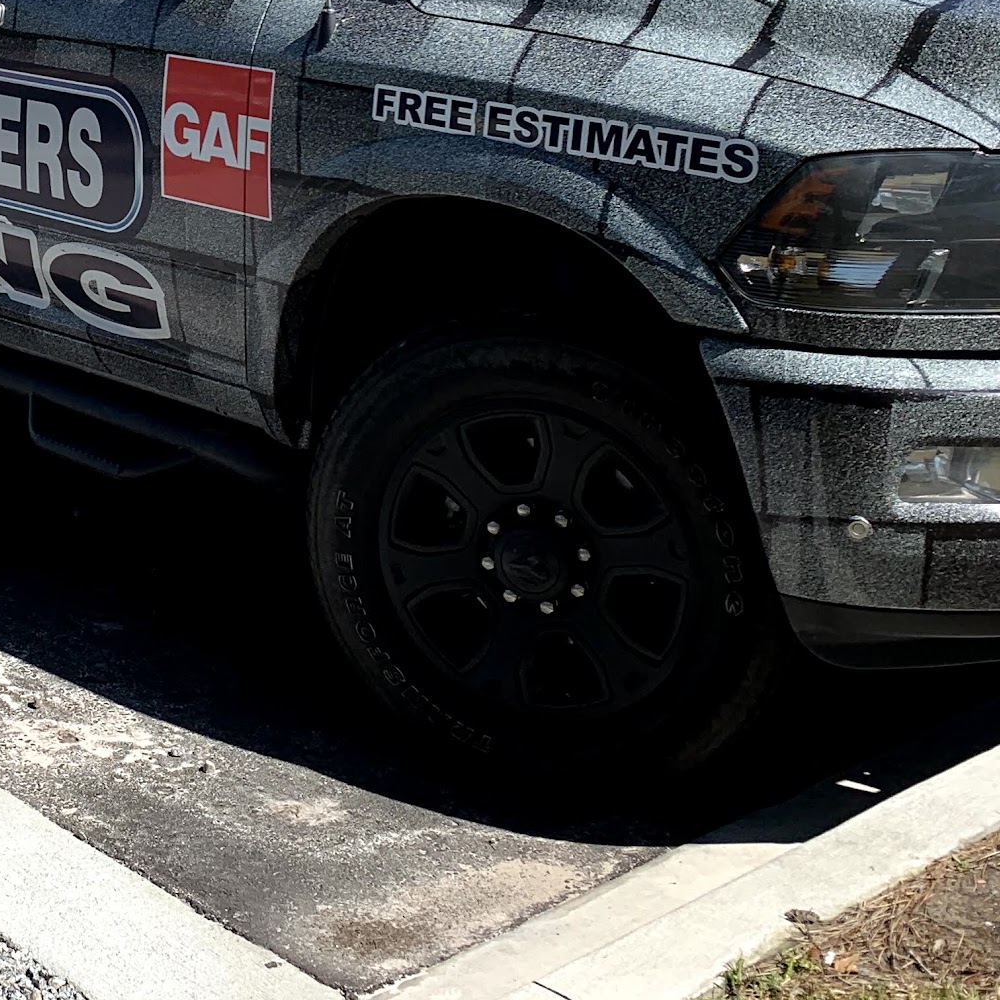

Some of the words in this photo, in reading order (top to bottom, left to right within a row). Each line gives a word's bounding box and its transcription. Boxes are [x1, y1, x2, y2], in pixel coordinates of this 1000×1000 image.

[163, 102, 270, 173] GAF
[373, 84, 477, 135] FREE
[482, 100, 759, 184] ESTIMATES
[592, 381, 744, 616] Festone
